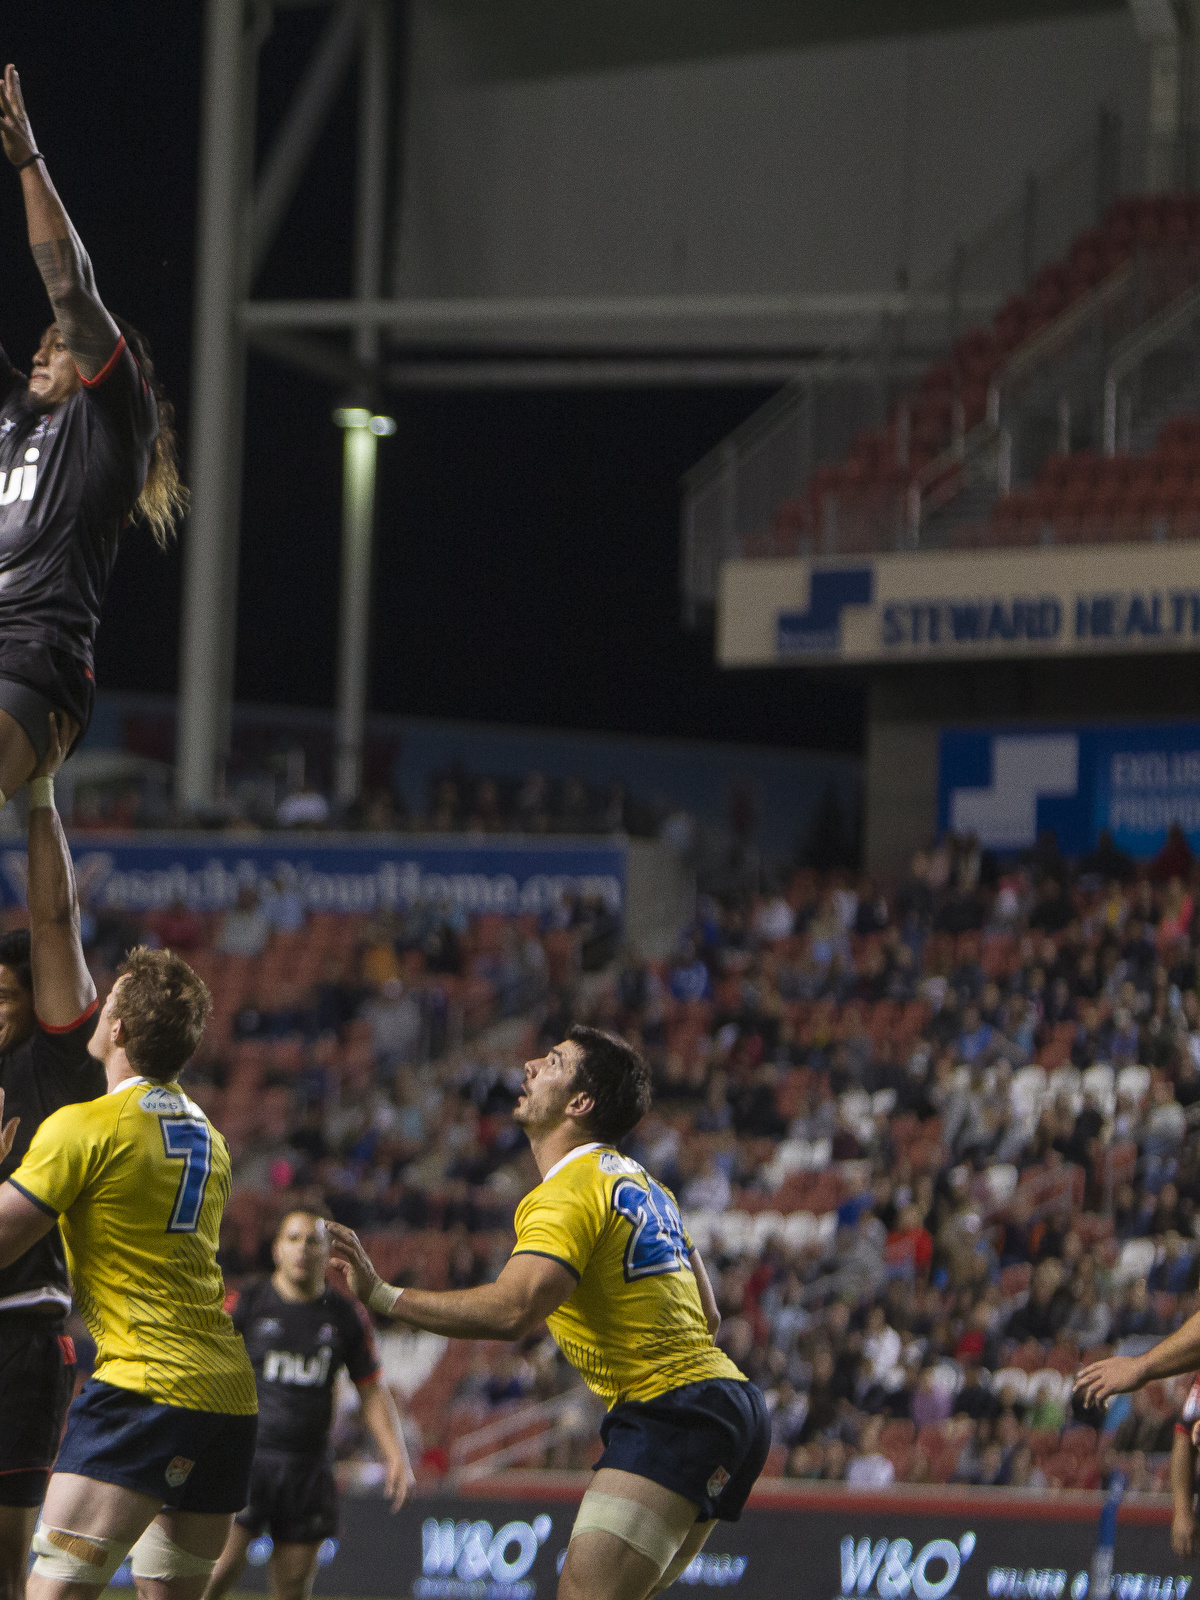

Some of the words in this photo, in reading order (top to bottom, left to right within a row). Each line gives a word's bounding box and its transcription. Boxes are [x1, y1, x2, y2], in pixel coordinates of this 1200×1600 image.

[882, 596, 1062, 644] STEWARD
[158, 1114, 212, 1234] 7
[262, 1345, 333, 1387] nui
